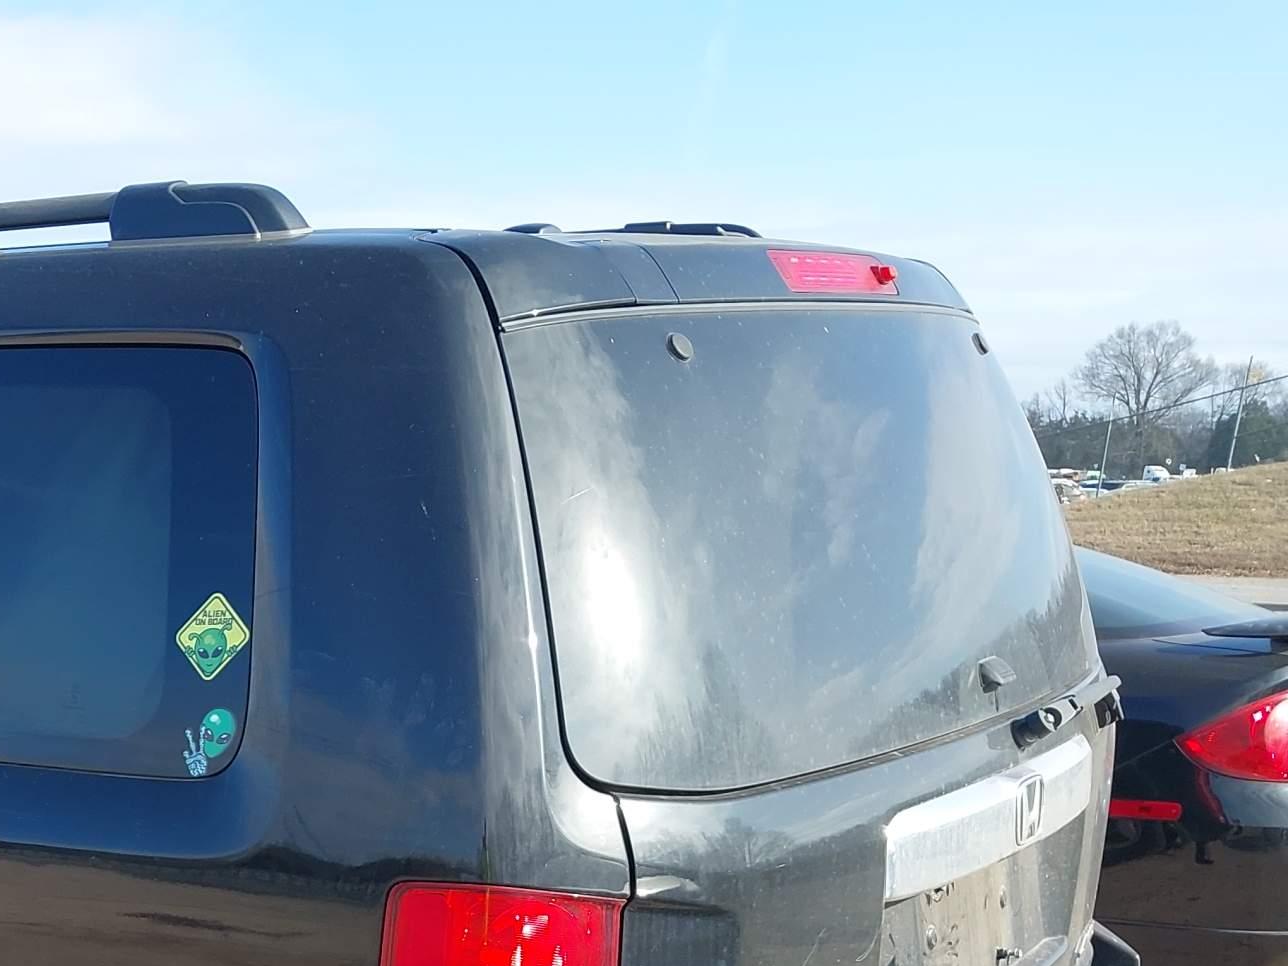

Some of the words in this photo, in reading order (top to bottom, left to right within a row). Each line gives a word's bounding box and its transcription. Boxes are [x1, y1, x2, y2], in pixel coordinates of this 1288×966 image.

[202, 609, 227, 618] ALIEN
[195, 617, 207, 626] ON
[207, 617, 233, 626] BOARD
